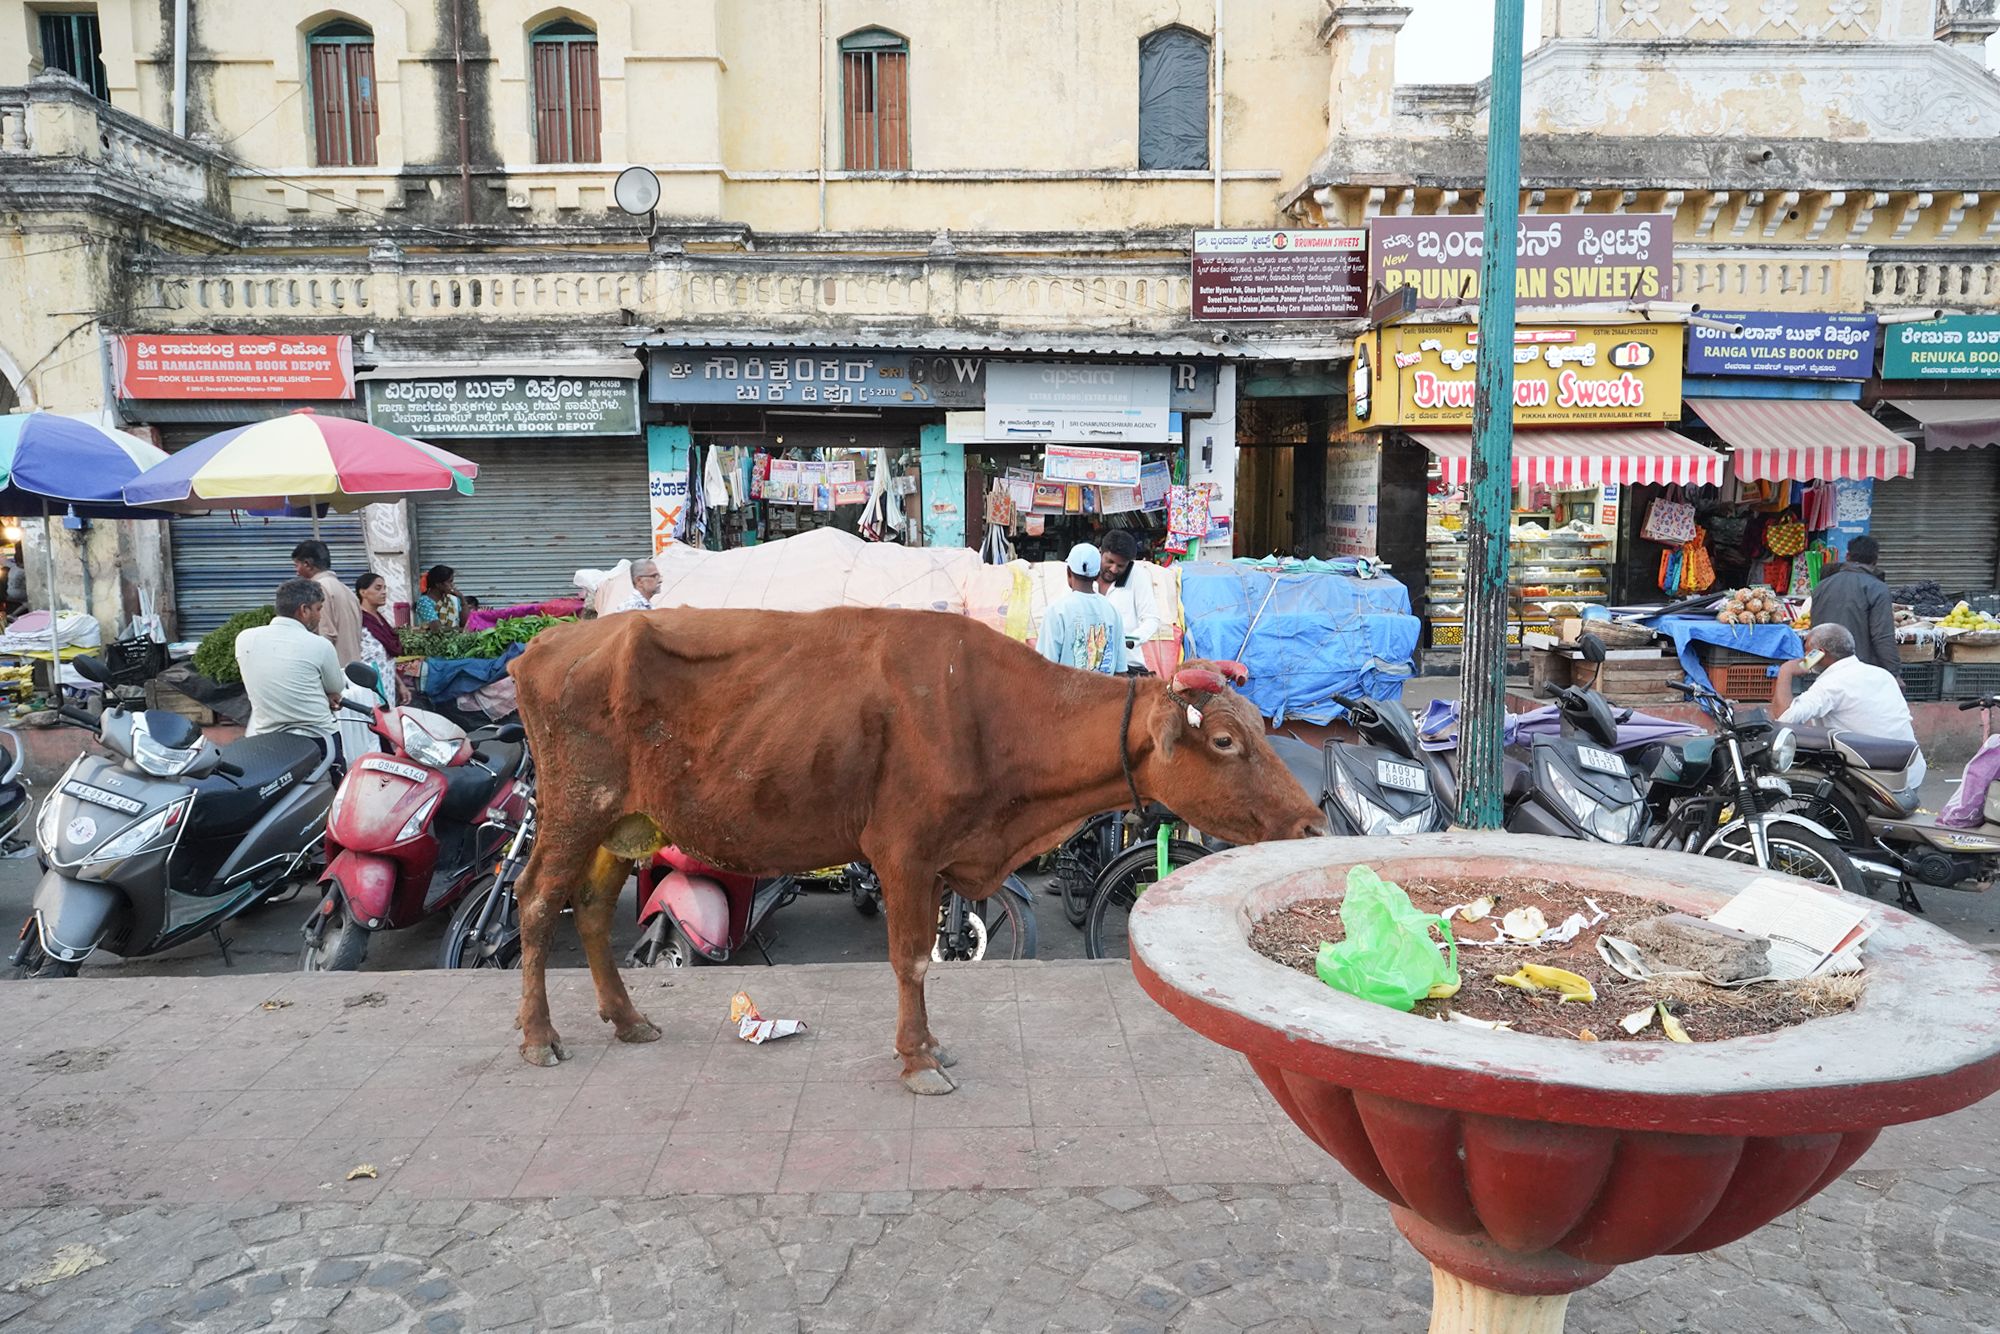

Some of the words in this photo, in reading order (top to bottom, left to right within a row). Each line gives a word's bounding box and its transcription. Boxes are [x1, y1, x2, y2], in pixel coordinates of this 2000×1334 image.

[1295, 237, 1332, 248] BRUNDAVAN
[1334, 237, 1360, 248] SWEETS
[1417, 222, 1562, 264] ಬೃಂದನ್
[1578, 221, 1651, 264] ಸ್ವೀಟ್ಸ್
[1382, 253, 1409, 268] New
[1385, 267, 1546, 299] BRUNDAN
[1553, 266, 1660, 299] SWEETS
[1200, 286, 1215, 294] Butter
[1215, 286, 1232, 295] Mysore
[1244, 286, 1256, 294] Ghee
[1256, 286, 1273, 295] Mysore
[1304, 286, 1321, 294] Mysore
[1203, 305, 1227, 313] Mushroom
[1276, 305, 1288, 313] Baby
[1302, 304, 1323, 312] Available
[1324, 304, 1331, 312] On
[1346, 303, 1358, 311] Price
[1786, 325, 1821, 342] ಬುಕ್
[1901, 327, 1963, 344] ರೇಣುಕಾ
[137, 342, 157, 358] ಶ್ರೀ
[161, 342, 235, 359] ರಾಮಚಂದ್ರ
[239, 341, 276, 356] ಬುಕ್
[281, 342, 327, 356] ಡಿಪೋ
[1704, 346, 1748, 358] RANGA
[1751, 347, 1786, 359] VILAS
[1789, 348, 1824, 360] BOOK
[1827, 349, 1859, 360] DEPO
[1911, 351, 1966, 363] RENUKA
[1969, 352, 2000, 363] BOO
[137, 360, 158, 371] SRI
[162, 360, 252, 371] RAMACHANDRA
[255, 361, 287, 371] BOOK
[291, 361, 332, 371] DEPOT
[879, 367, 904, 379] SRI
[1041, 367, 1115, 389] apsara
[384, 379, 457, 402] ವಿಶ್ವನಾಥ
[465, 378, 516, 399] ಬುಕ್
[736, 381, 793, 401] ಬುಕ್
[1416, 373, 1546, 406] Brunan
[1559, 372, 1643, 406] Sweets
[1634, 411, 1651, 419] HERE
[412, 423, 515, 432] VISHWANATHA
[518, 423, 553, 432] BOOK
[557, 422, 597, 431] DEPOT
[1079, 421, 1133, 429] CHAMUNDESHWARI
[1588, 748, 1598, 758] KA
[377, 761, 399, 773] 09HA
[403, 767, 425, 781] 4140
[1385, 763, 1417, 778] KA09J
[1386, 773, 1417, 789] D8801
